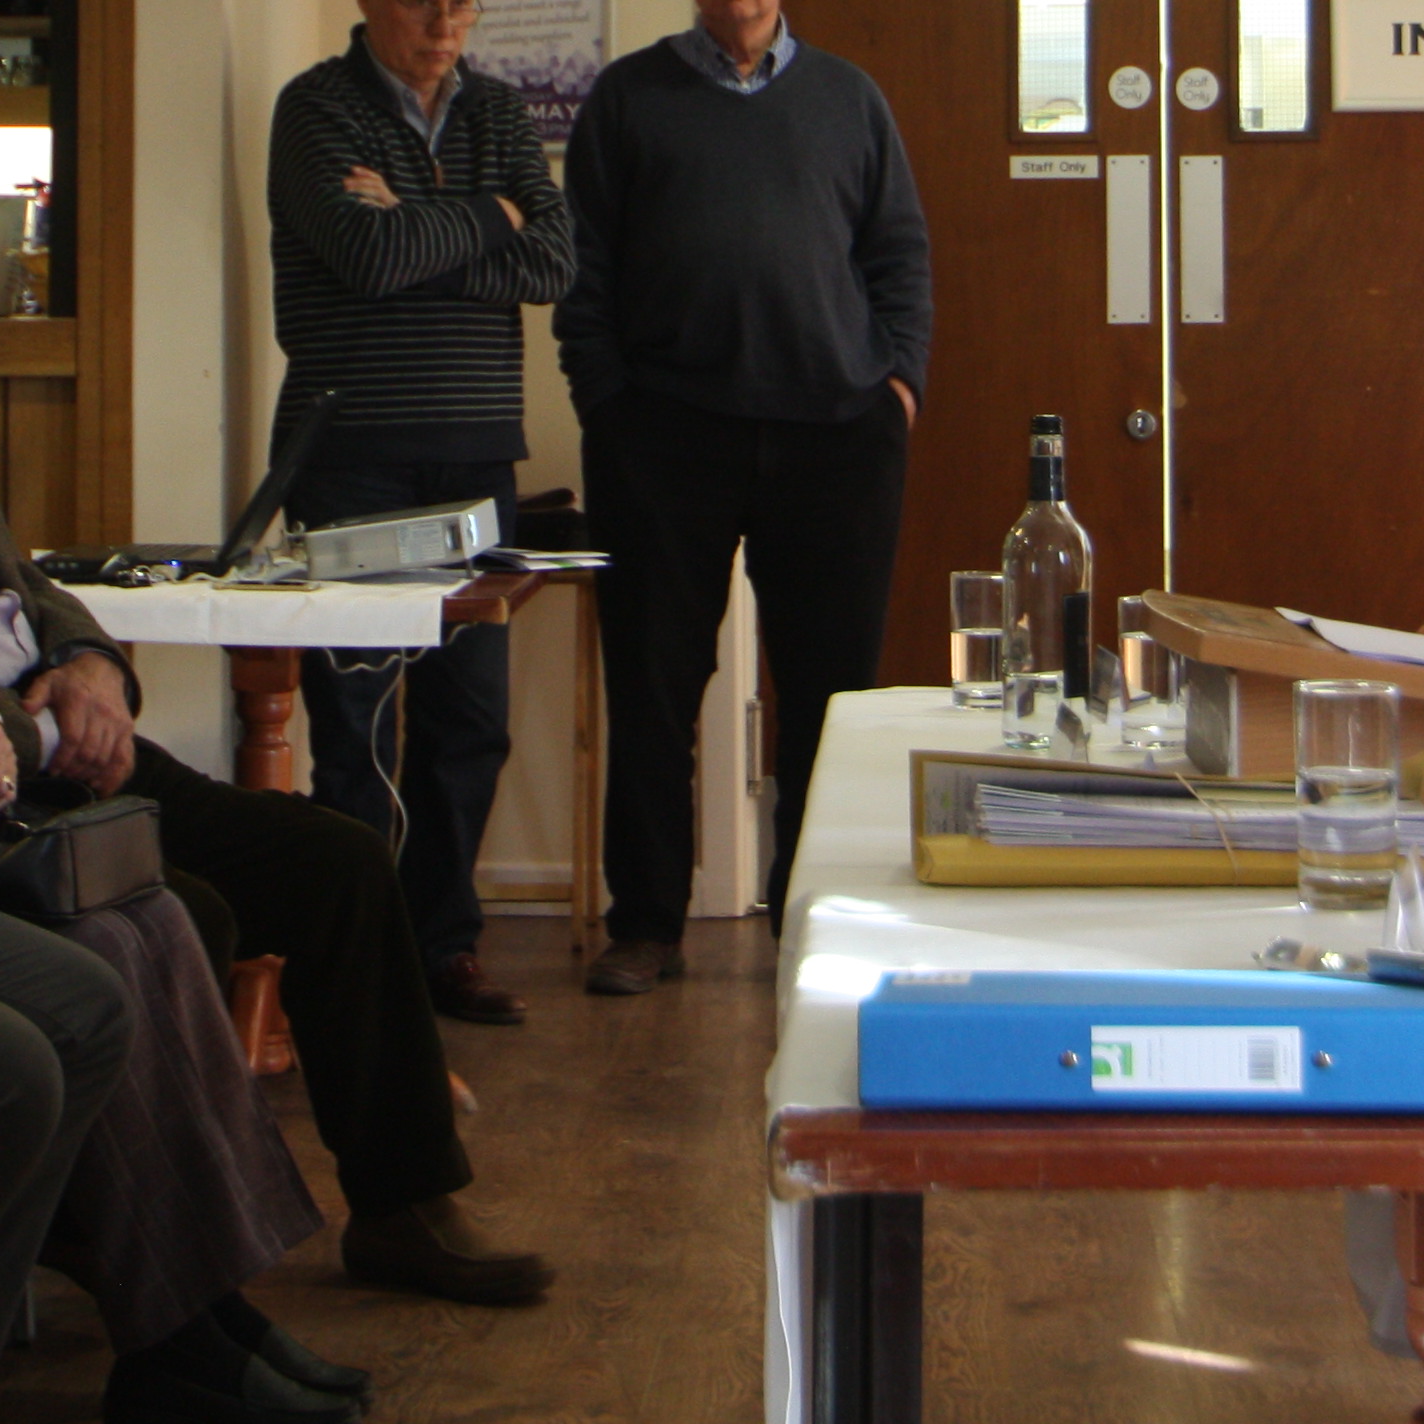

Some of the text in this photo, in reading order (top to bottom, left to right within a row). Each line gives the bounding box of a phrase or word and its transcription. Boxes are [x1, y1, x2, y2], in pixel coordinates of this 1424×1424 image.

[1117, 75, 1141, 86] Staff
[1183, 76, 1208, 87] Staff
[1116, 88, 1142, 102] Only
[1183, 90, 1210, 103] Only
[527, 102, 581, 120] MAY
[1021, 162, 1086, 174] Staff Only
